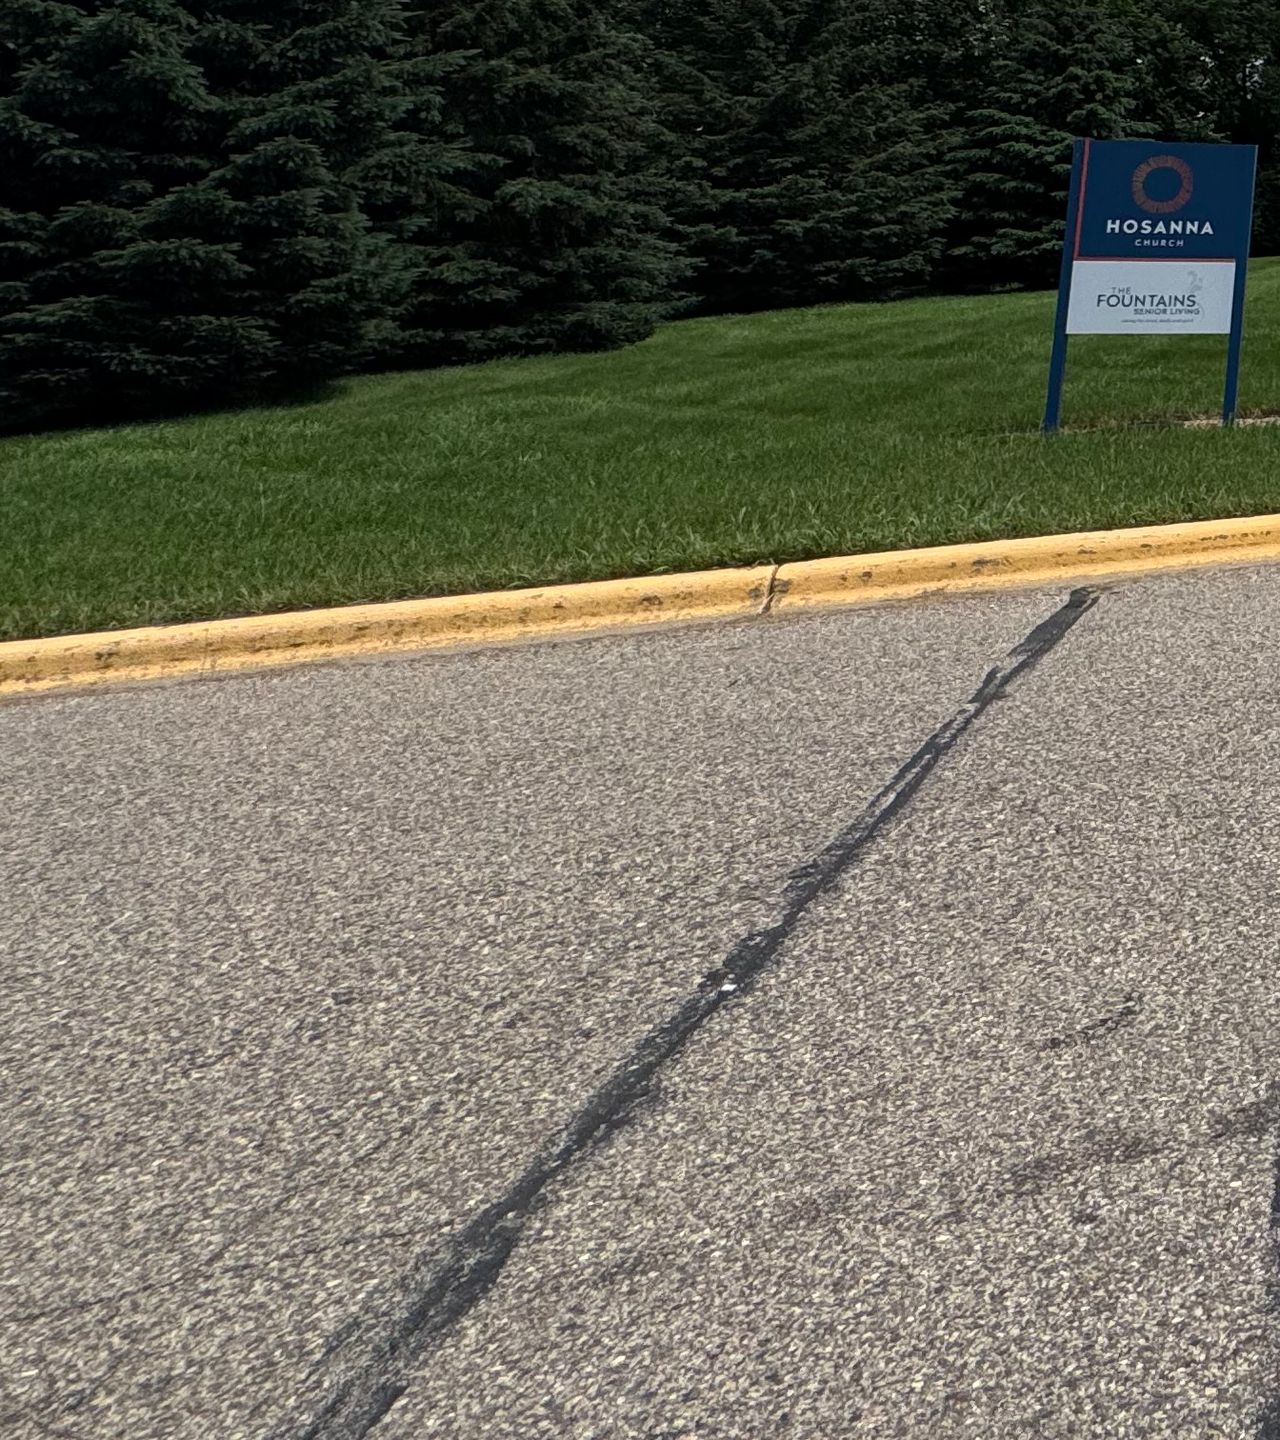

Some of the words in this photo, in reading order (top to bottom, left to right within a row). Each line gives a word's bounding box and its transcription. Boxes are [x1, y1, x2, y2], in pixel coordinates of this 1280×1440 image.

[1106, 219, 1214, 235] HOSANNA
[1134, 239, 1184, 247] CHURCH
[1111, 287, 1131, 295] THE
[1096, 294, 1197, 308] FOUNTAINS
